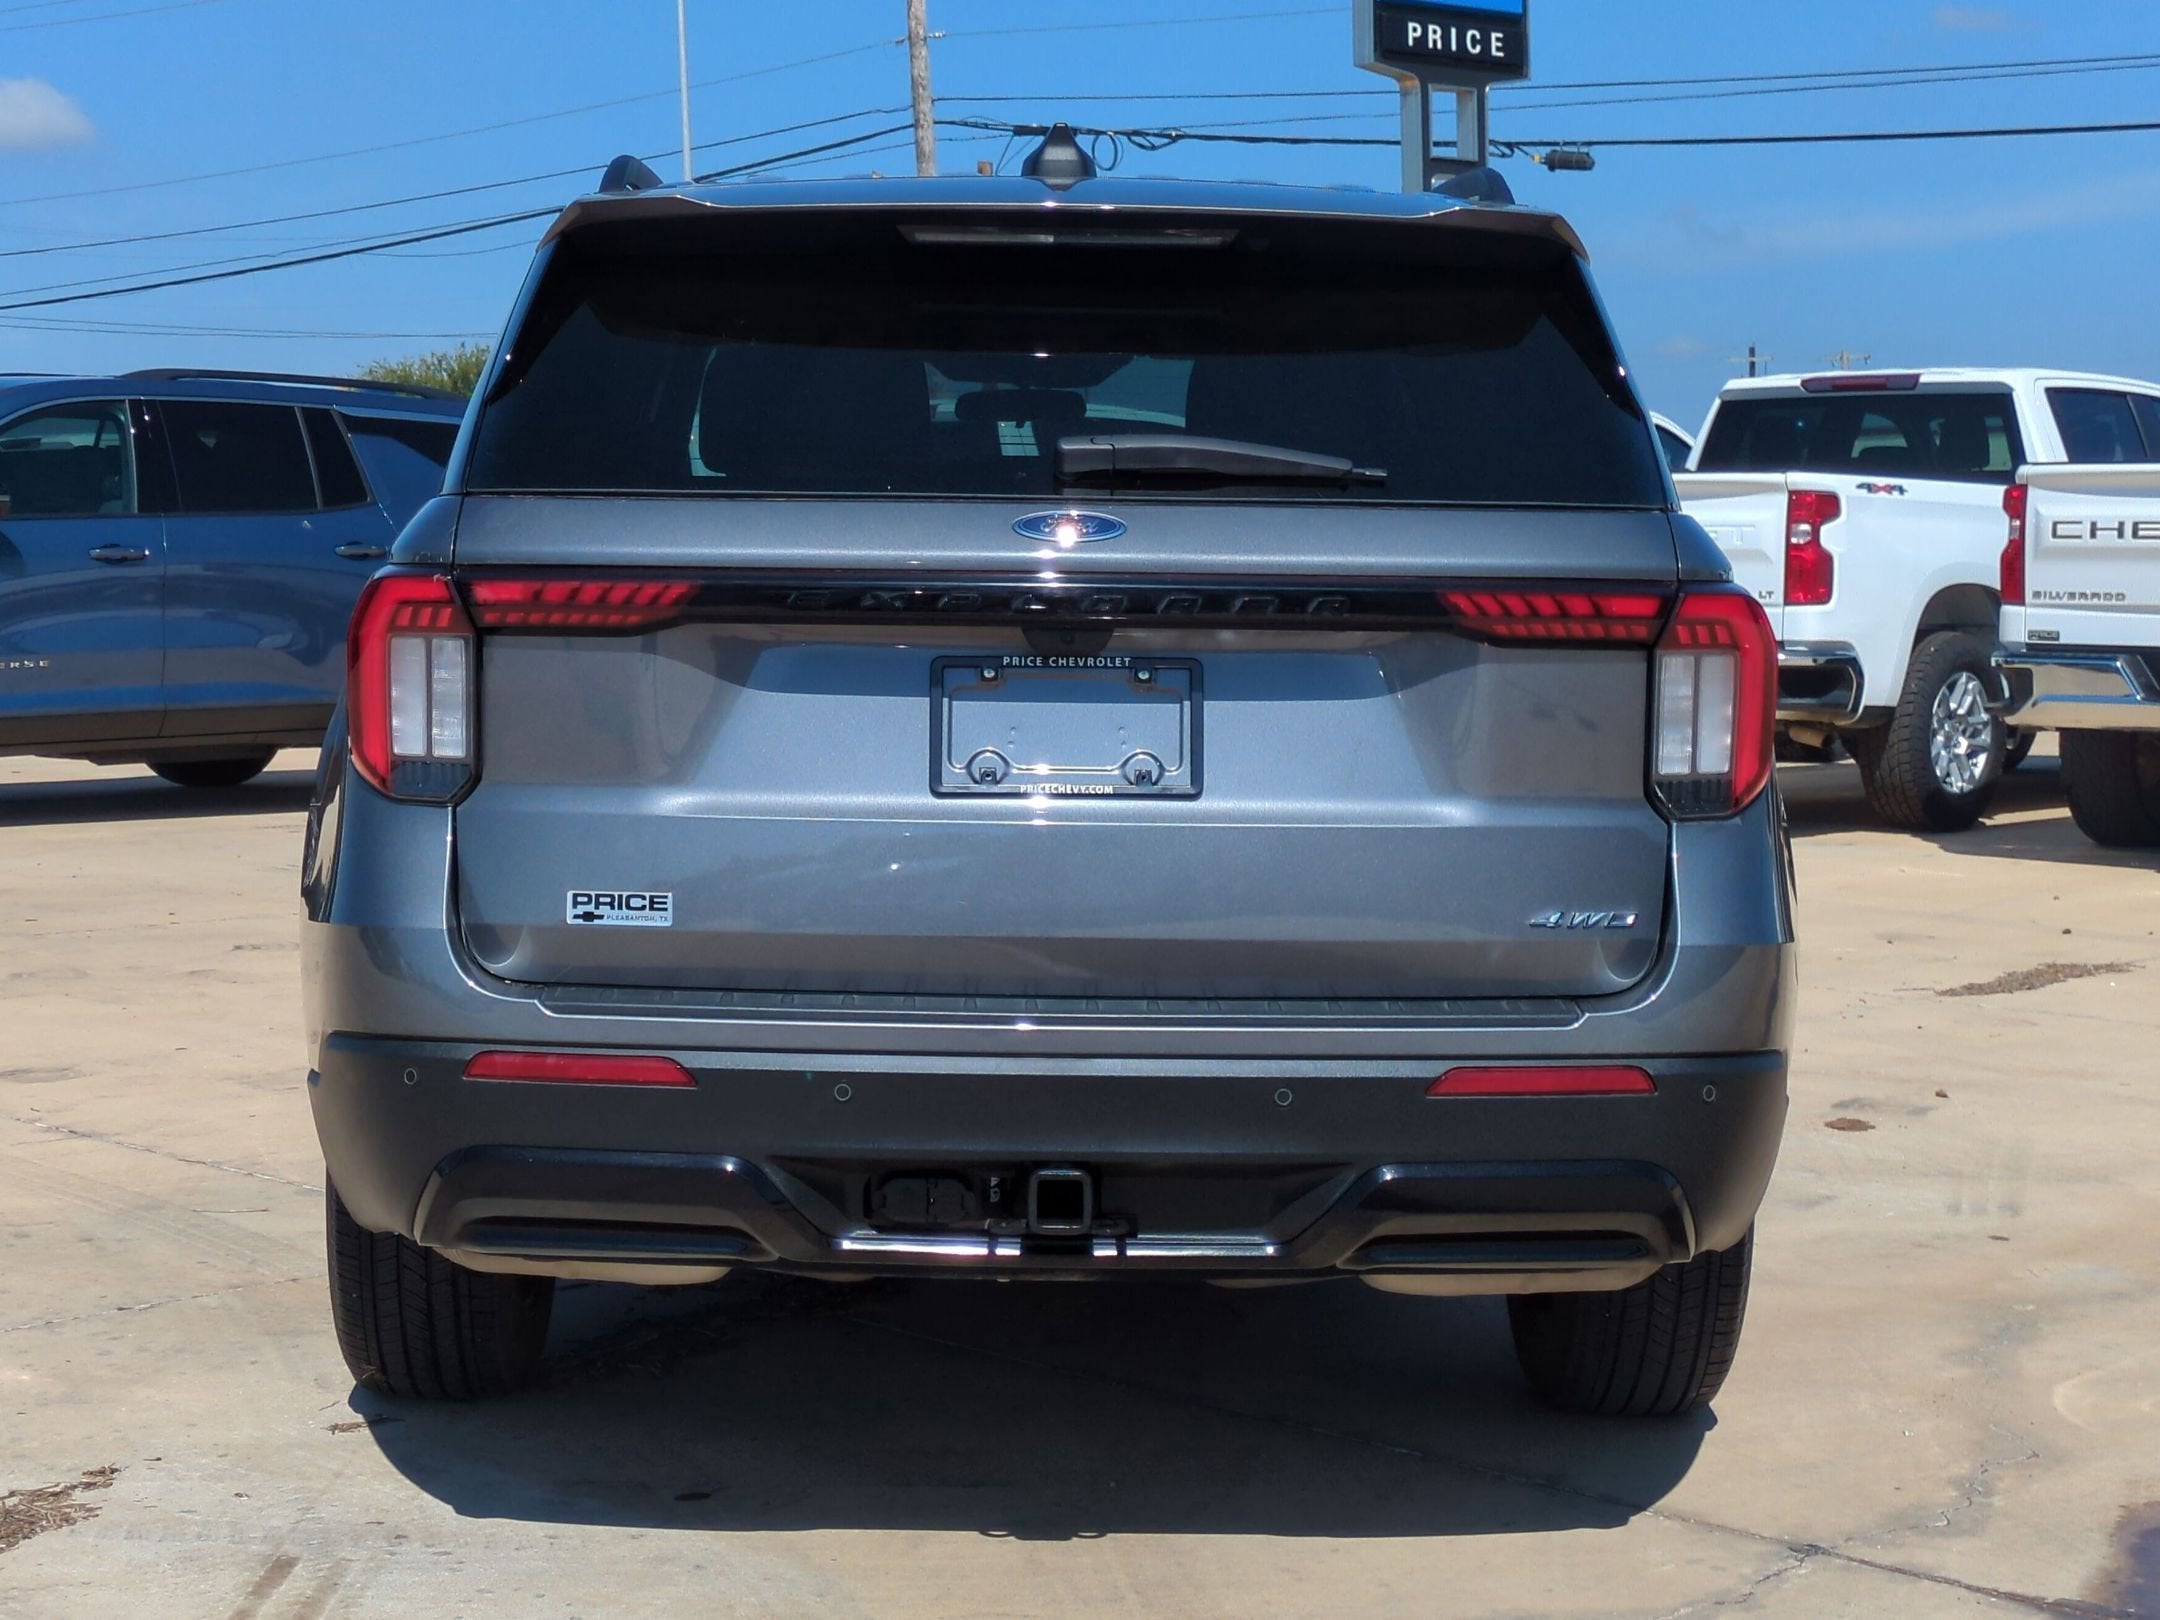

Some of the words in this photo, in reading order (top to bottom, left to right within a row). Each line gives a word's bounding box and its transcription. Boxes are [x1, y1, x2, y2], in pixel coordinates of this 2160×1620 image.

[1408, 22, 1504, 57] PRICE
[2051, 521, 2160, 539] CHE
[1758, 591, 1774, 600] LT
[2031, 591, 2127, 602] SILVERADO
[1003, 656, 1044, 666] PRICE
[1048, 657, 1132, 667] CHEVROLET
[1020, 784, 1114, 794] PRICECHEVY.COM
[572, 893, 668, 912] PRICE
[1528, 911, 1638, 928] 4WD
